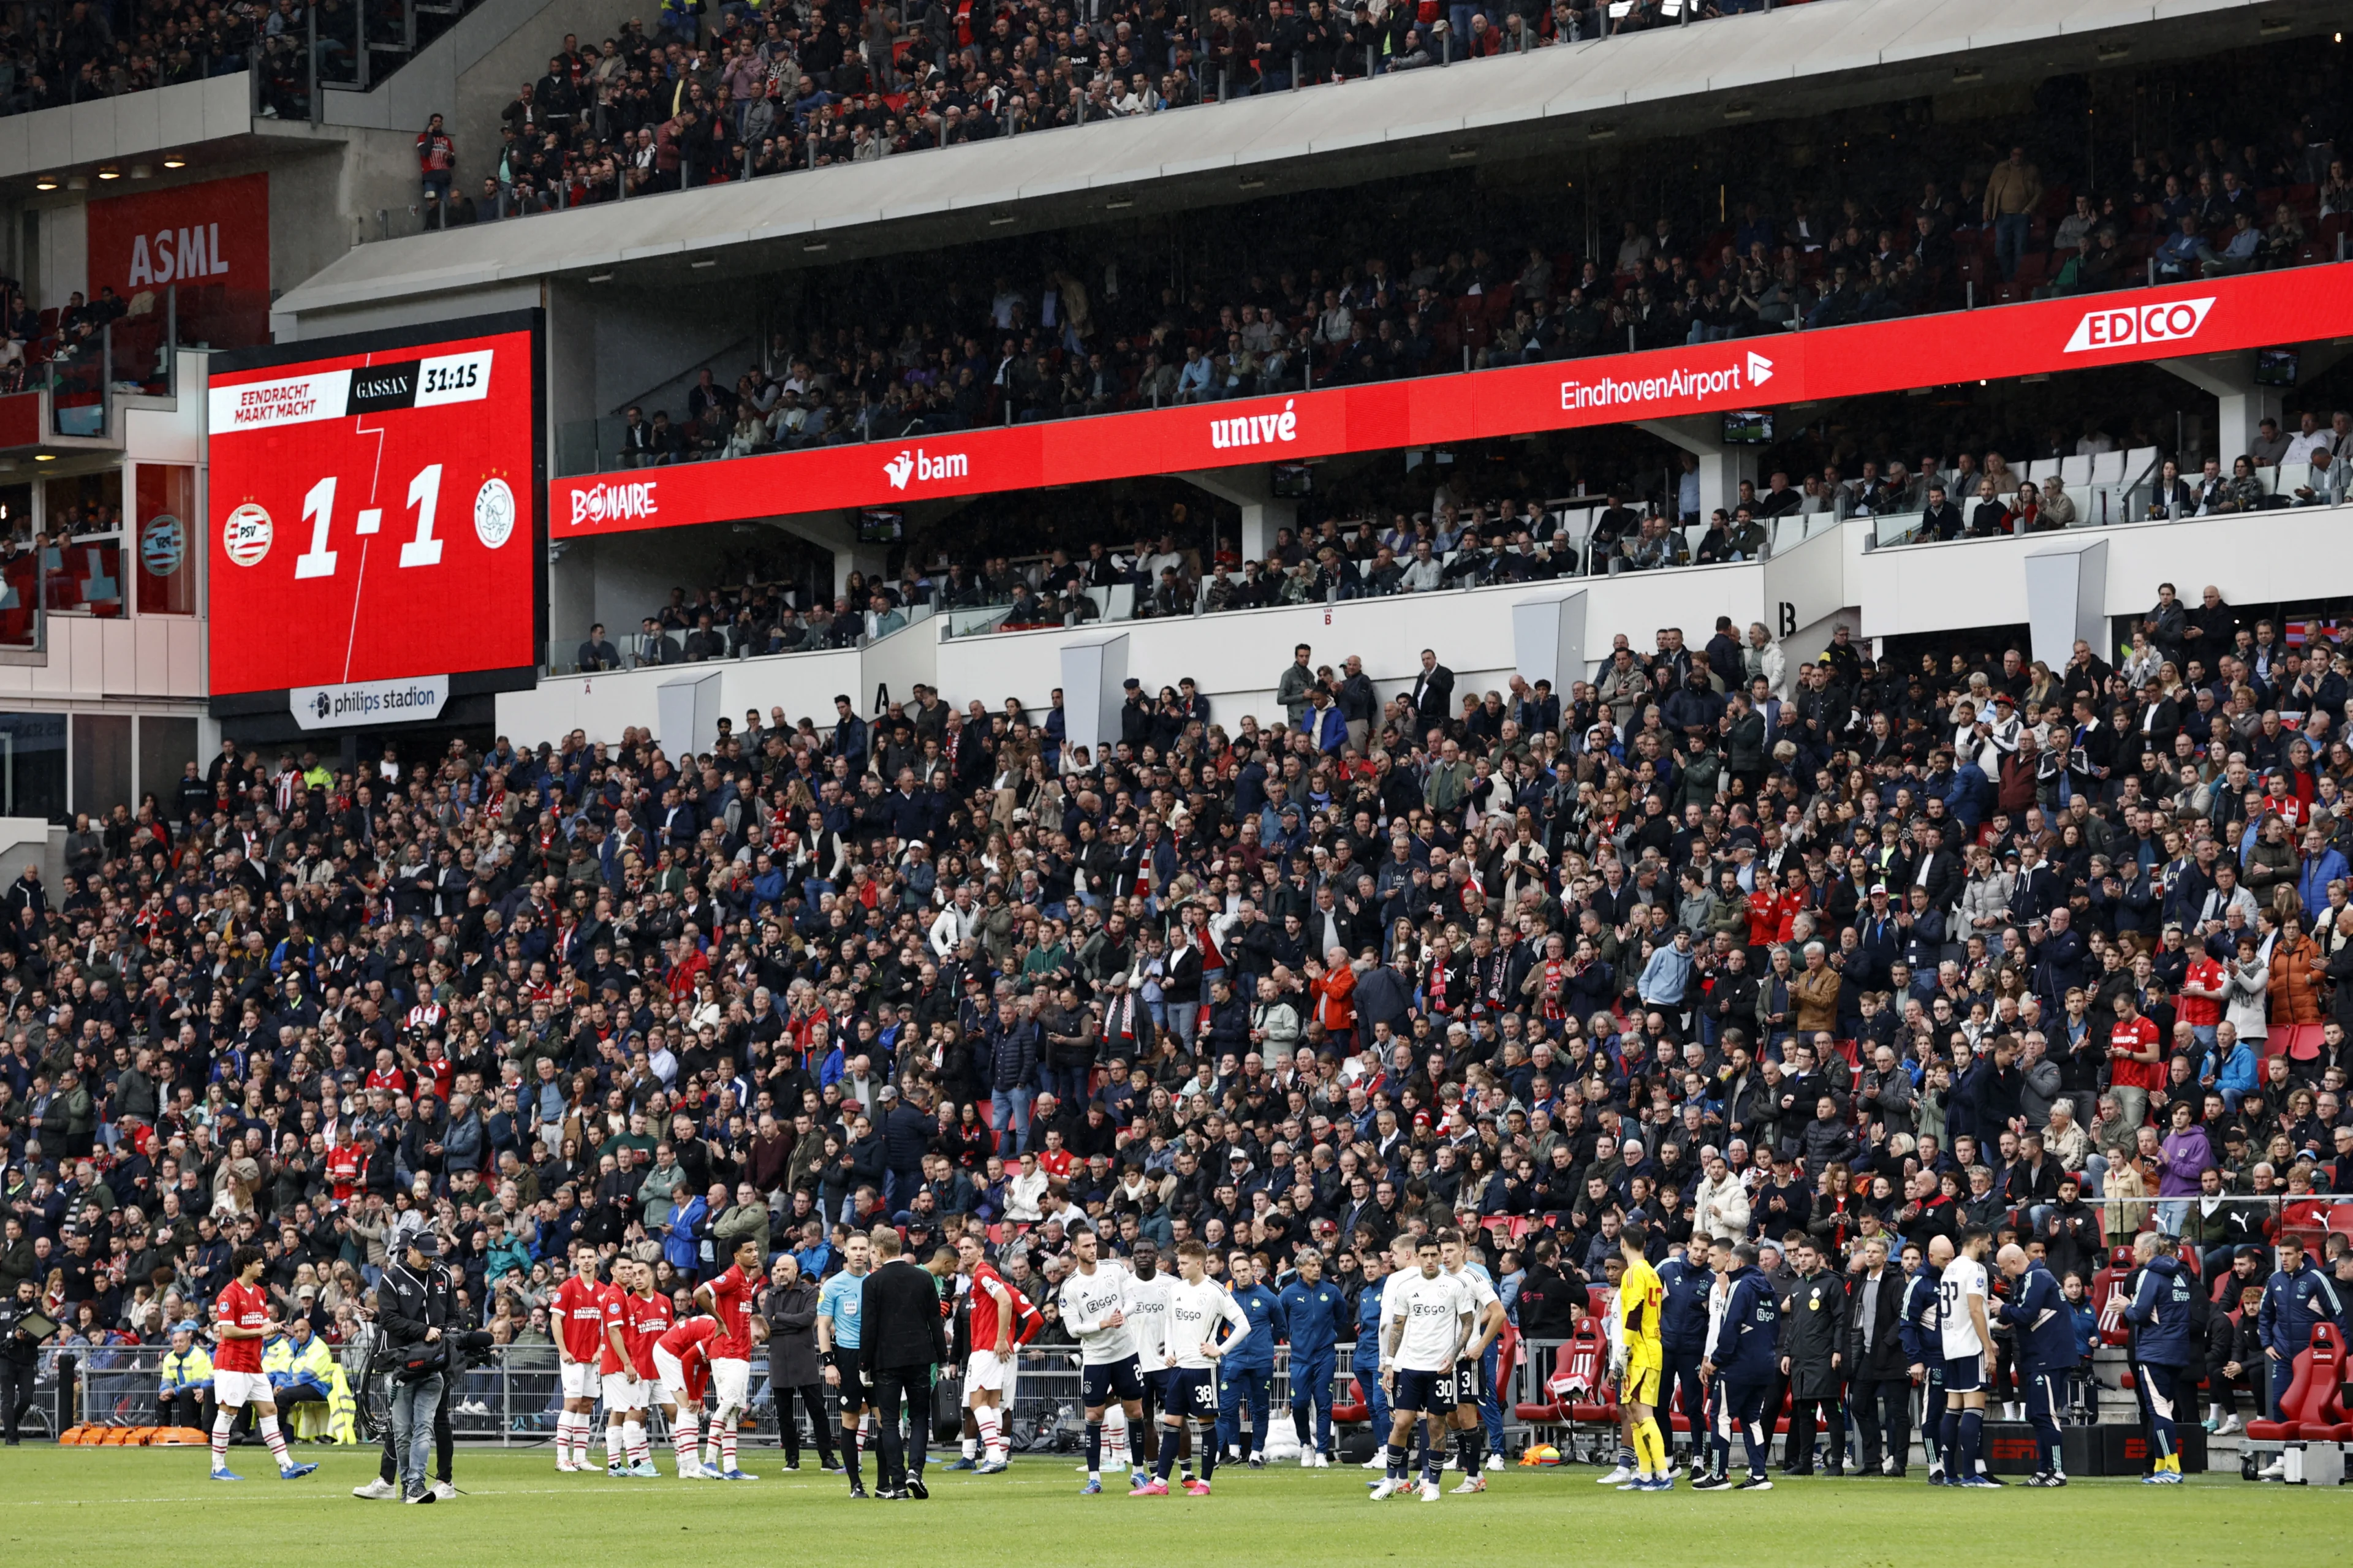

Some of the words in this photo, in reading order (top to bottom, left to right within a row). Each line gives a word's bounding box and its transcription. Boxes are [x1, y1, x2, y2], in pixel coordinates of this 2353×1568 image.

[129, 222, 229, 288] ASML
[2088, 304, 2197, 346] EDICO
[357, 376, 408, 400] GASSAN
[424, 363, 478, 393] 31:15
[1561, 363, 1741, 410] EindhovenAirport
[241, 384, 311, 407] EENDRACHT
[234, 403, 276, 425] MAAKT
[276, 399, 317, 420] MACHT
[1210, 398, 1297, 449] univé
[917, 448, 968, 481] bam
[570, 480, 659, 528] BONAIRE
[240, 525, 256, 539] PSV
[1324, 614, 1332, 626] B
[1779, 602, 1797, 638] B
[335, 694, 381, 718] philips
[383, 687, 435, 710] stadion
[585, 684, 591, 694] A
[874, 683, 890, 714] A
[1194, 1385, 1213, 1403] 38
[1435, 1379, 1453, 1398] 30
[1461, 1371, 1471, 1388] 3
